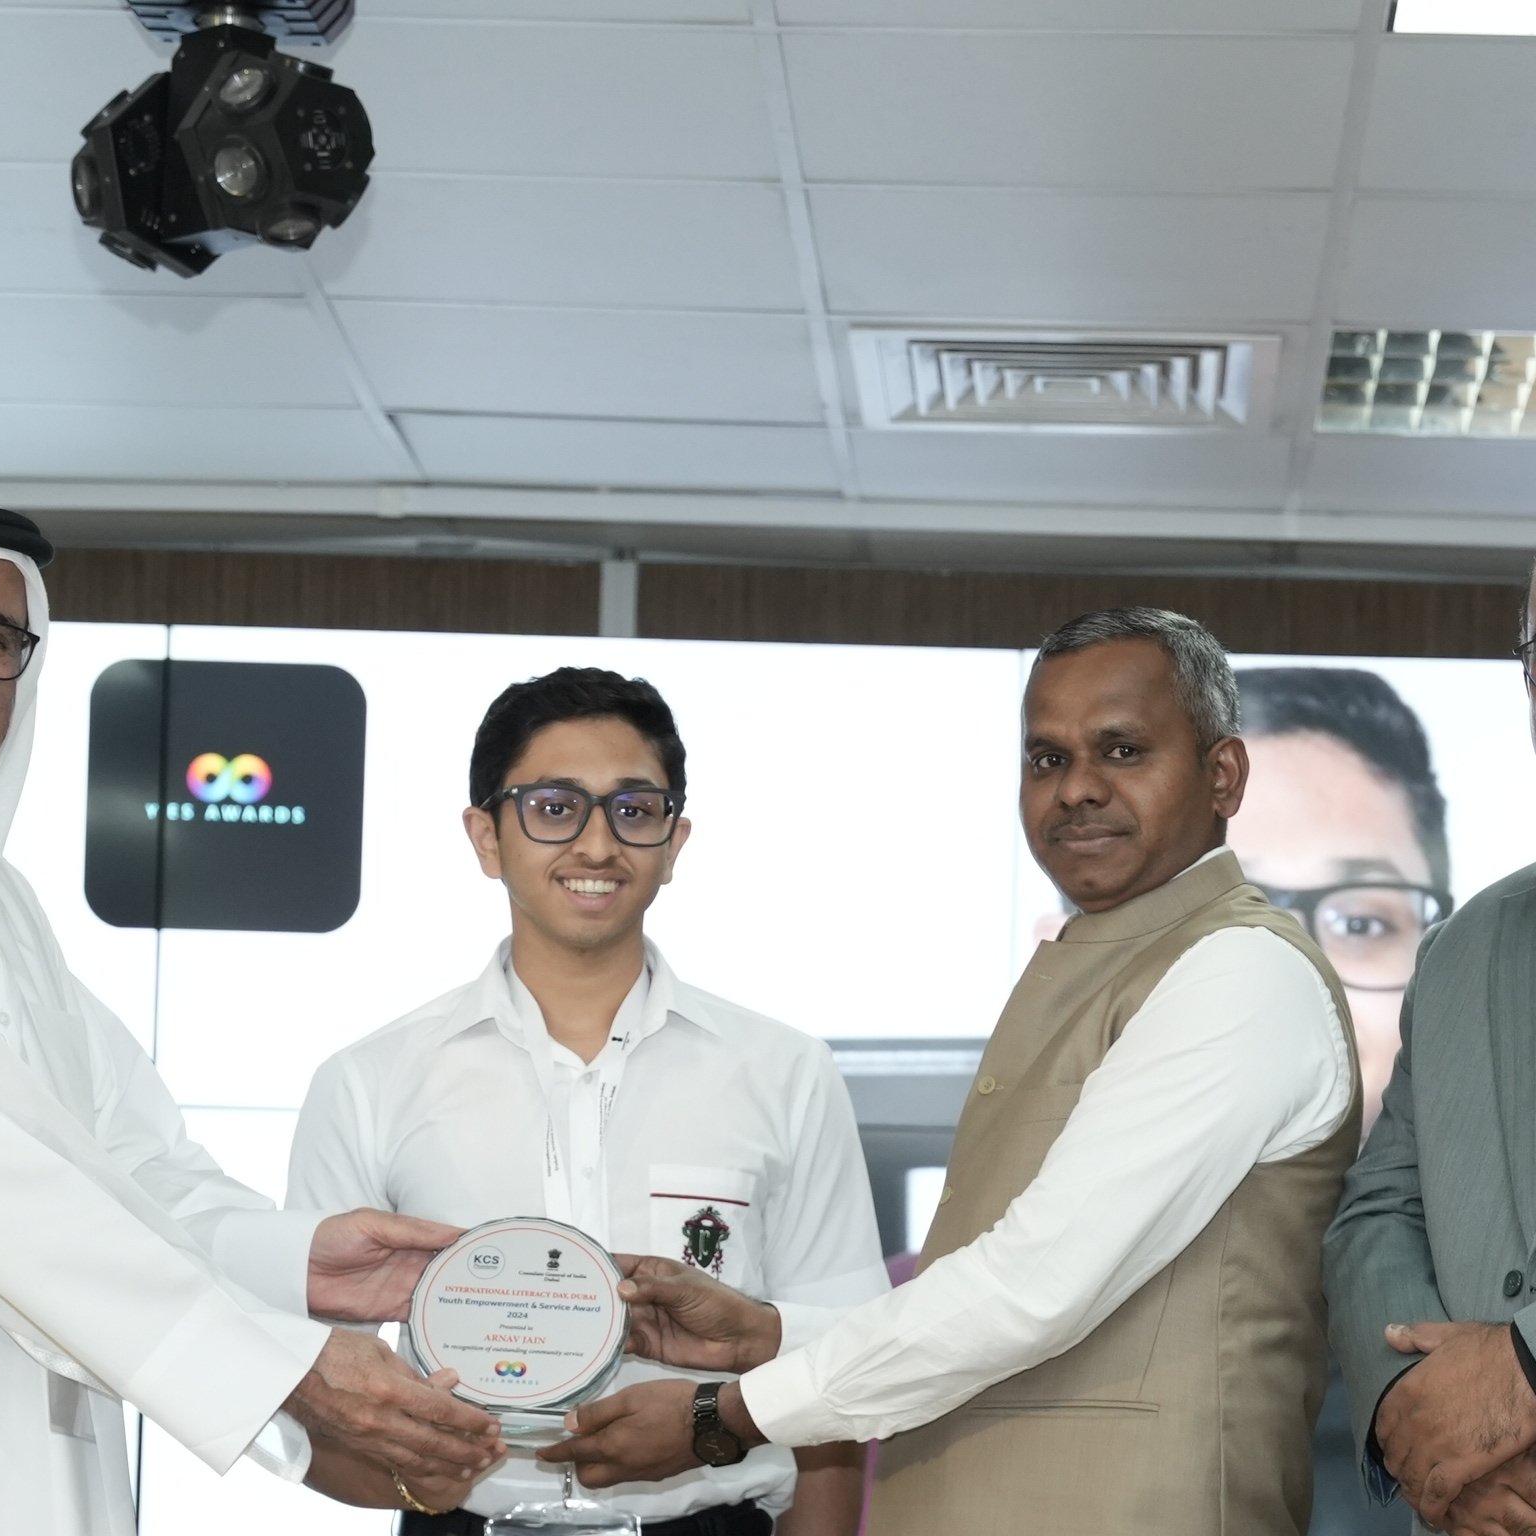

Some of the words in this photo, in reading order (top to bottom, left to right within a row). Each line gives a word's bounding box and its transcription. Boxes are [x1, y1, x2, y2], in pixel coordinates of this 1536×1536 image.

[144, 802, 195, 820] YES
[204, 803, 306, 825] AWARDS
[474, 1255, 499, 1264] KCS
[444, 1286, 510, 1295] INTERNATIONAL
[512, 1290, 551, 1298] LITERACY
[465, 1298, 529, 1308] Empowerment
[539, 1302, 571, 1311] Service
[572, 1304, 600, 1312] Award
[484, 1334, 521, 1343] ARNAV
[522, 1336, 546, 1344] JAIN
[492, 1347, 528, 1355] outstanding
